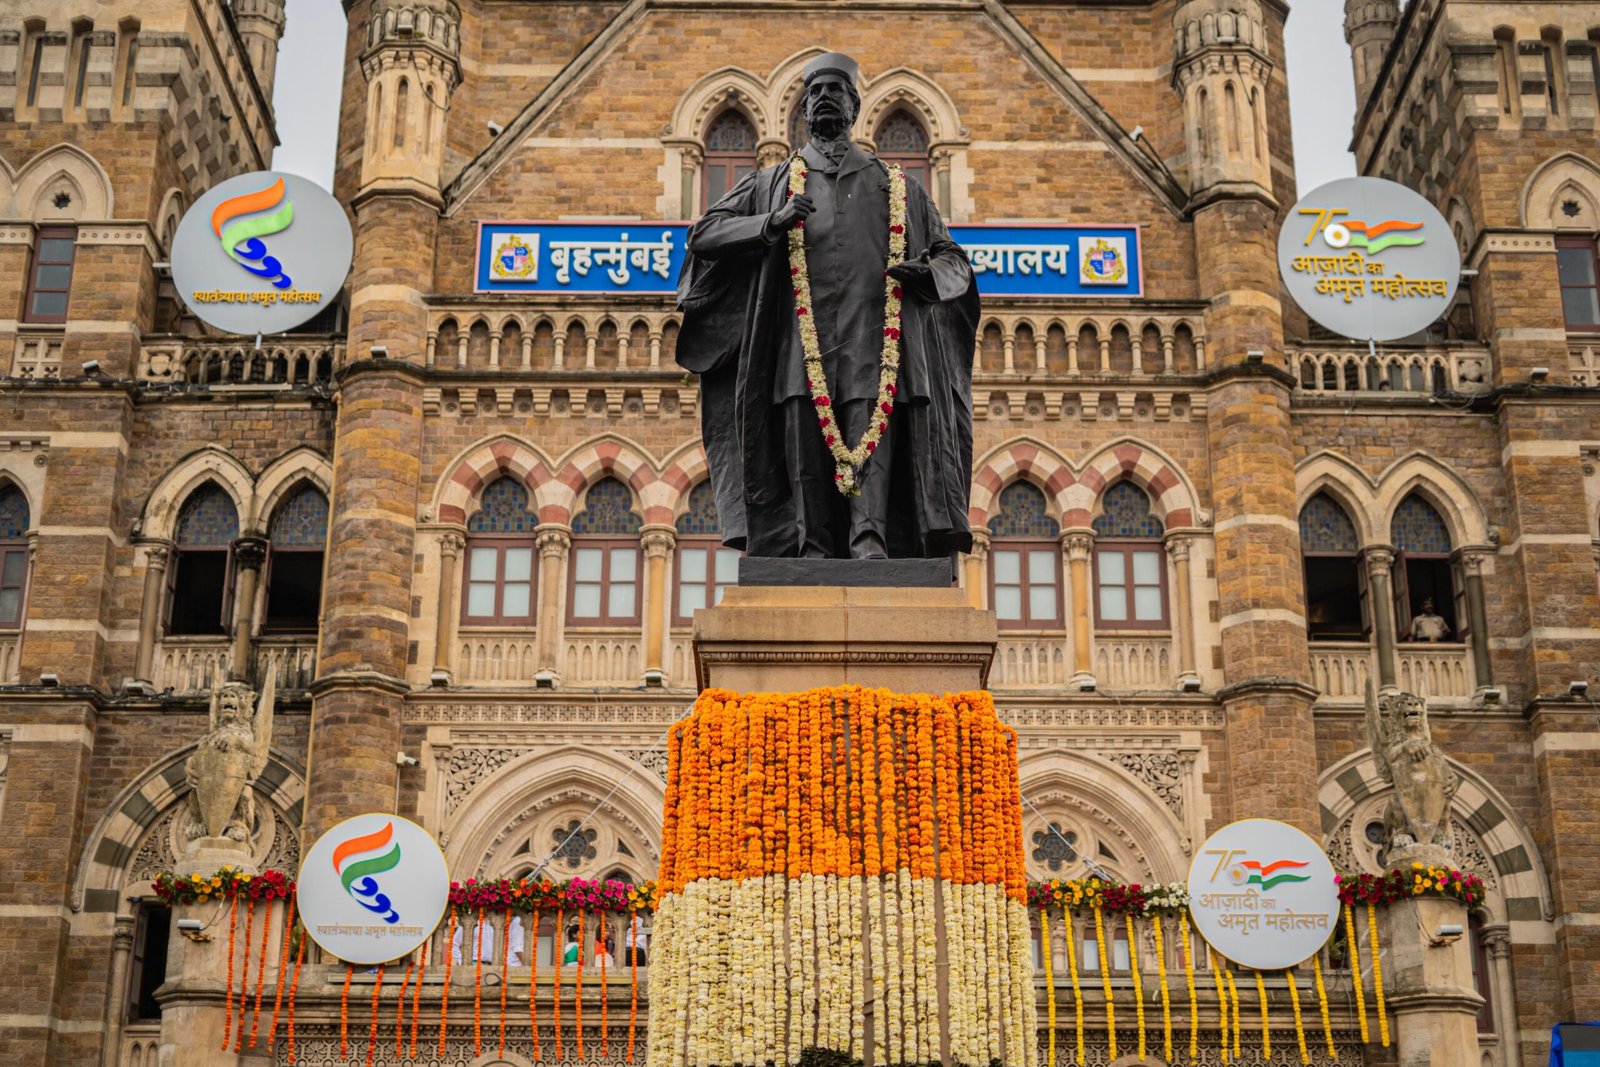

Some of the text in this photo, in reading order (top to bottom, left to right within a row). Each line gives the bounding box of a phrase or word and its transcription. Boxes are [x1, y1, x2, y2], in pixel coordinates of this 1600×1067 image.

[549, 231, 1069, 285] बृहन्मुंबई ख्यालय
[1366, 262, 1384, 275] का
[1315, 272, 1447, 303] अमृत महोत्सव
[250, 291, 278, 308] अमृत
[279, 288, 321, 304] महोत्सव
[1261, 899, 1276, 910] का
[1217, 907, 1329, 935] अमृत महोत्सव
[364, 925, 387, 940] अमृत
